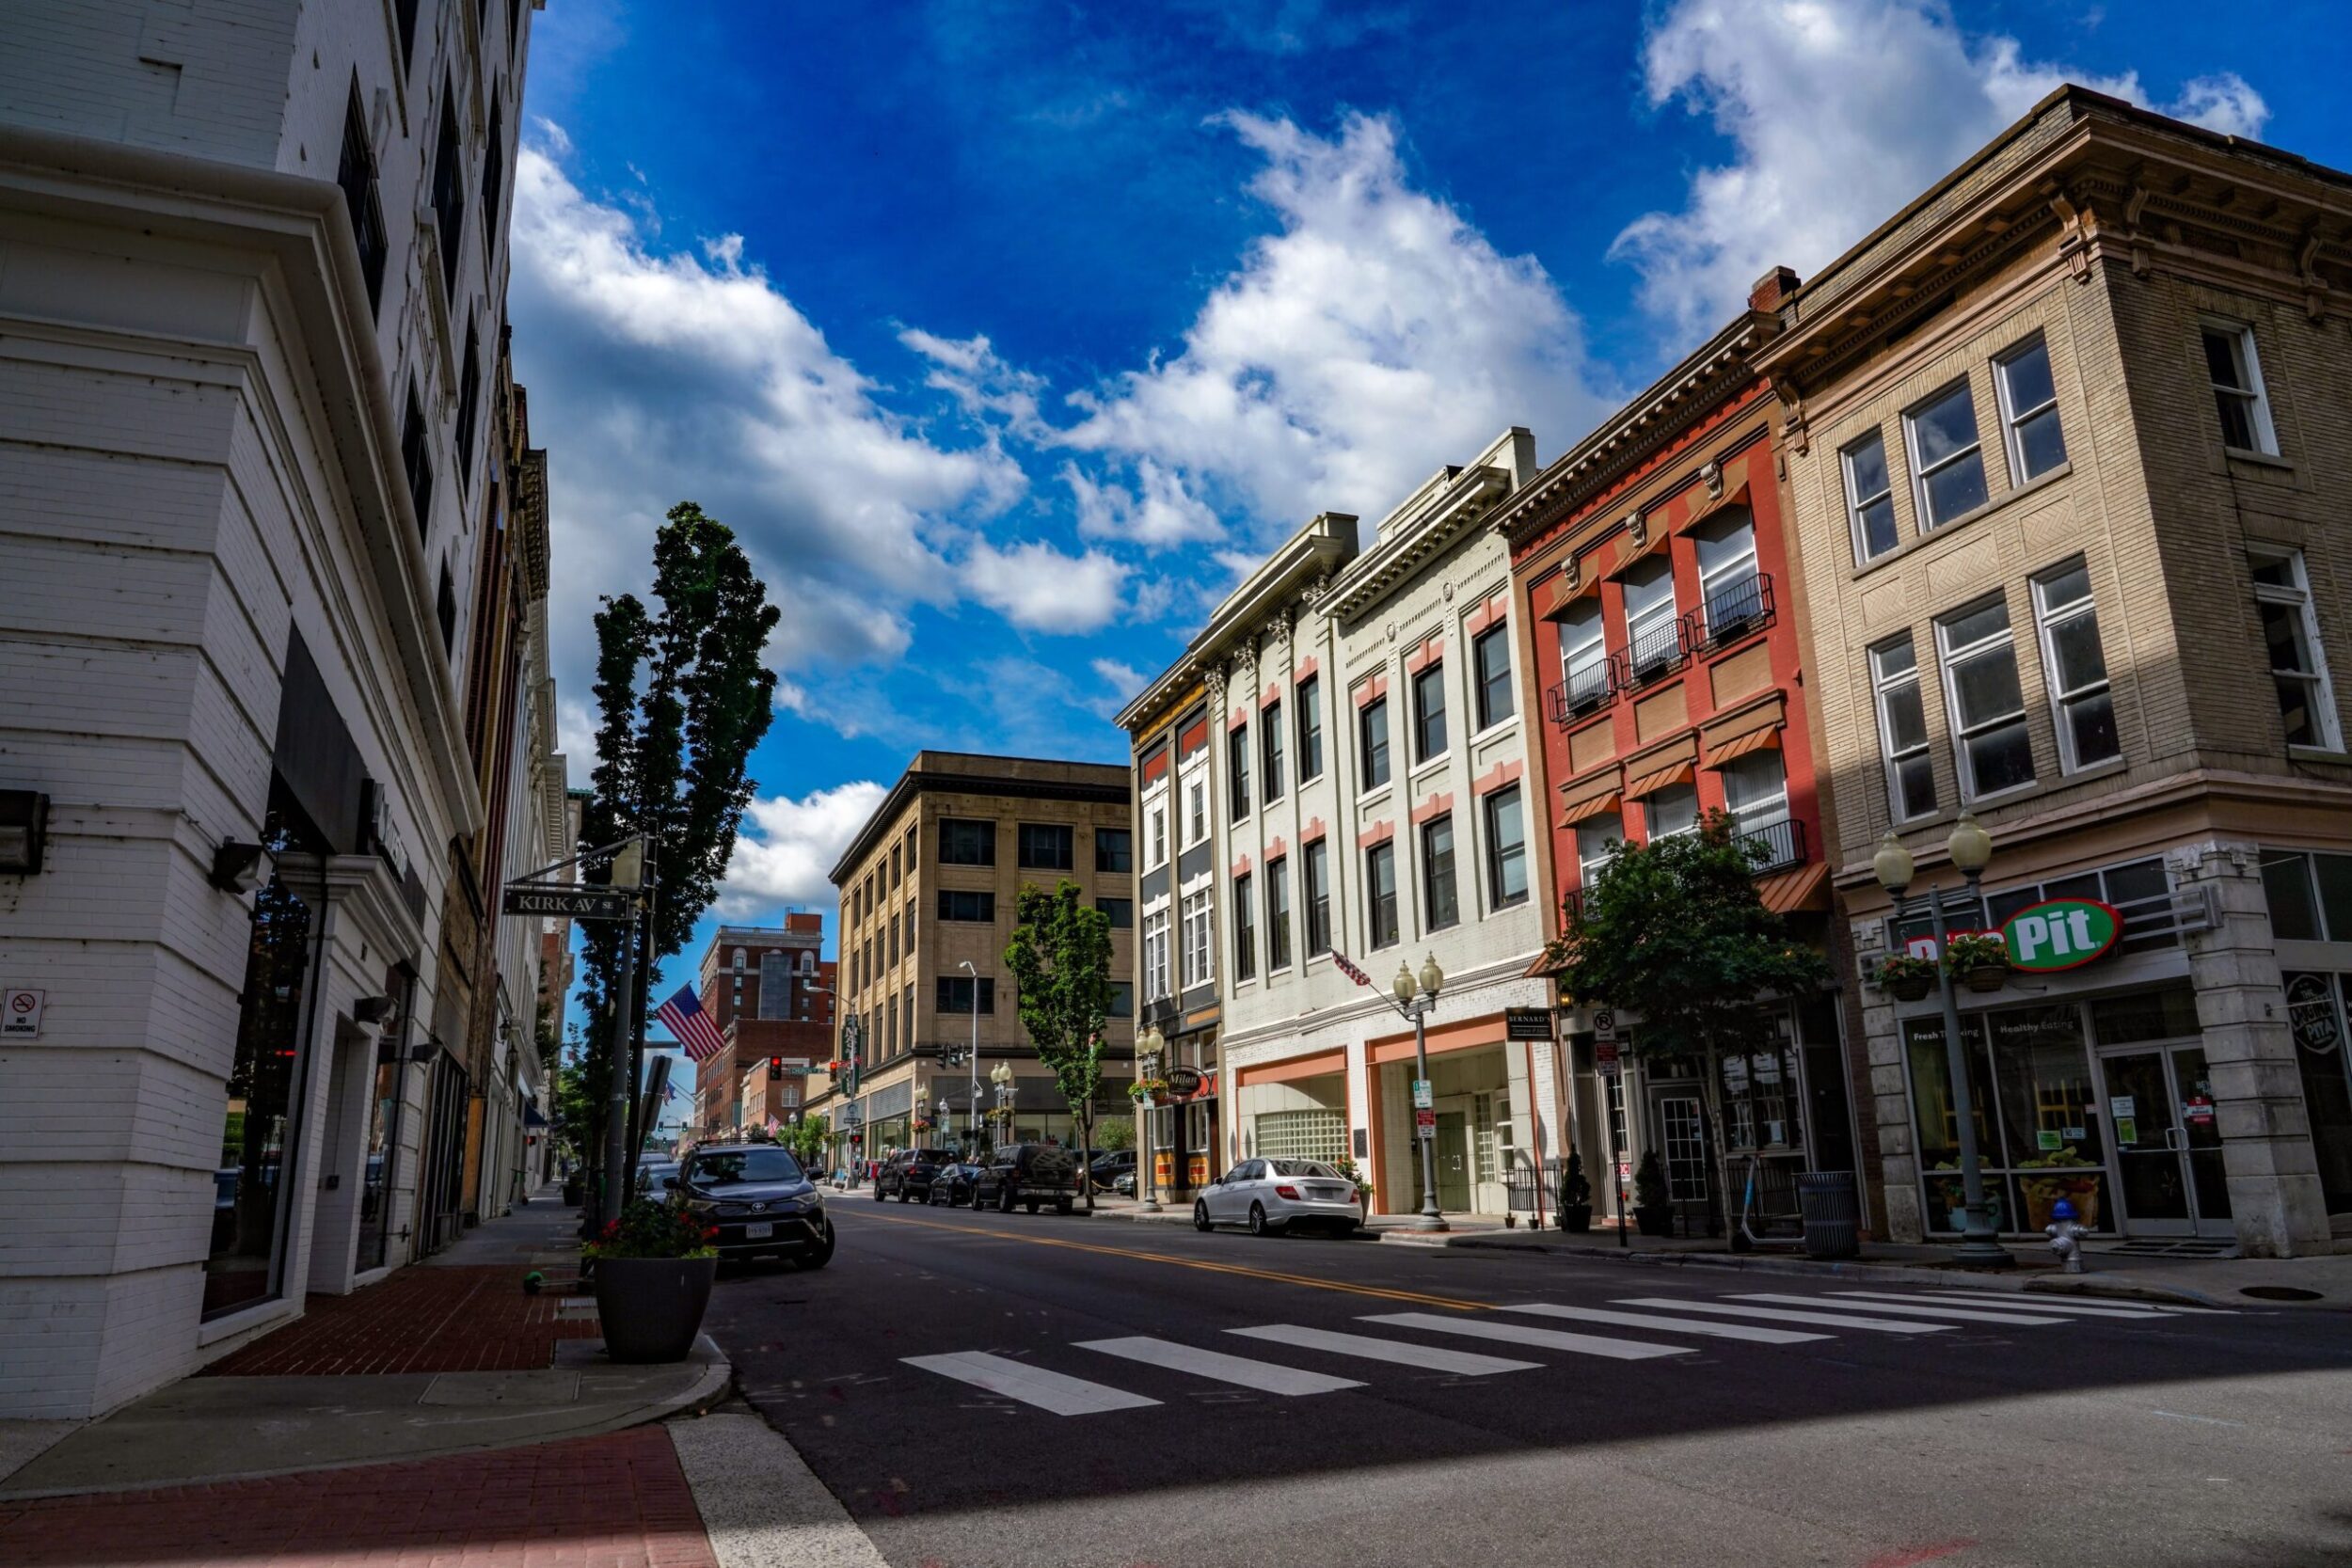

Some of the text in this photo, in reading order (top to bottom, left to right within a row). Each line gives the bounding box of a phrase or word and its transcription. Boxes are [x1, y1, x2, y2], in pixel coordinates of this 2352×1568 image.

[518, 895, 614, 912] KIRK AV SE
[2014, 909, 2096, 961] Pit
[1508, 1015, 1550, 1023] BERNARD'S
[1999, 1020, 2074, 1034] Healthy Eating
[2305, 1019, 2336, 1041] PITA
[1914, 1030, 1939, 1041] Fresh
[1168, 1073, 1198, 1085] Milan
